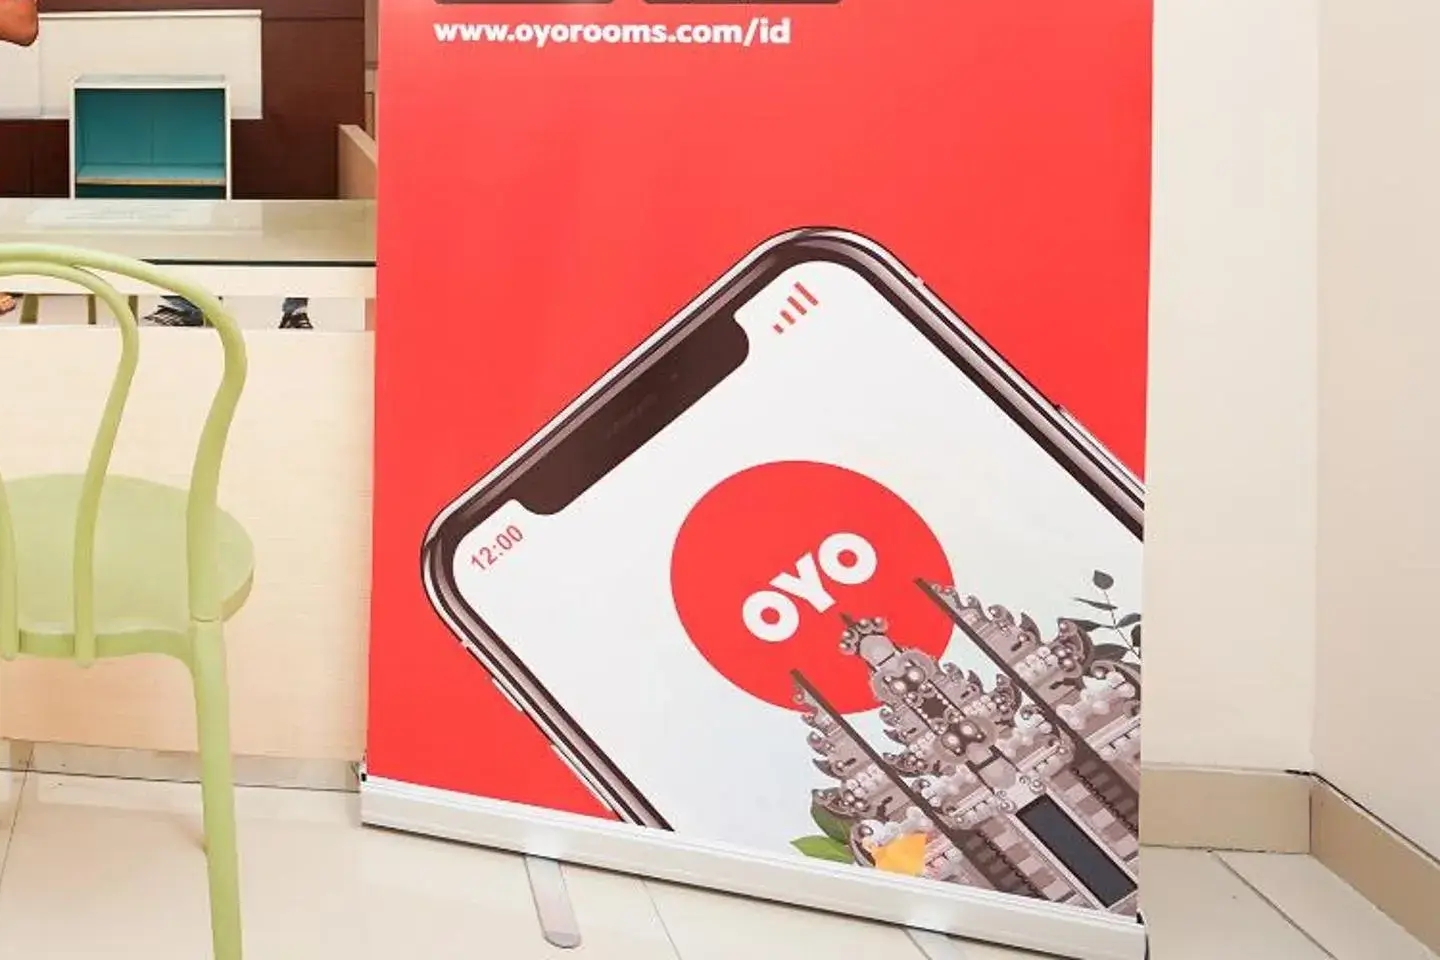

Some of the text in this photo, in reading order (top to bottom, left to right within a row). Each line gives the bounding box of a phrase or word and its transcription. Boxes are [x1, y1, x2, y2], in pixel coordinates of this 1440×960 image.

[433, 16, 791, 48] www.oyorooms.com/id
[469, 524, 524, 574] 12:00
[742, 533, 878, 643] OYO
